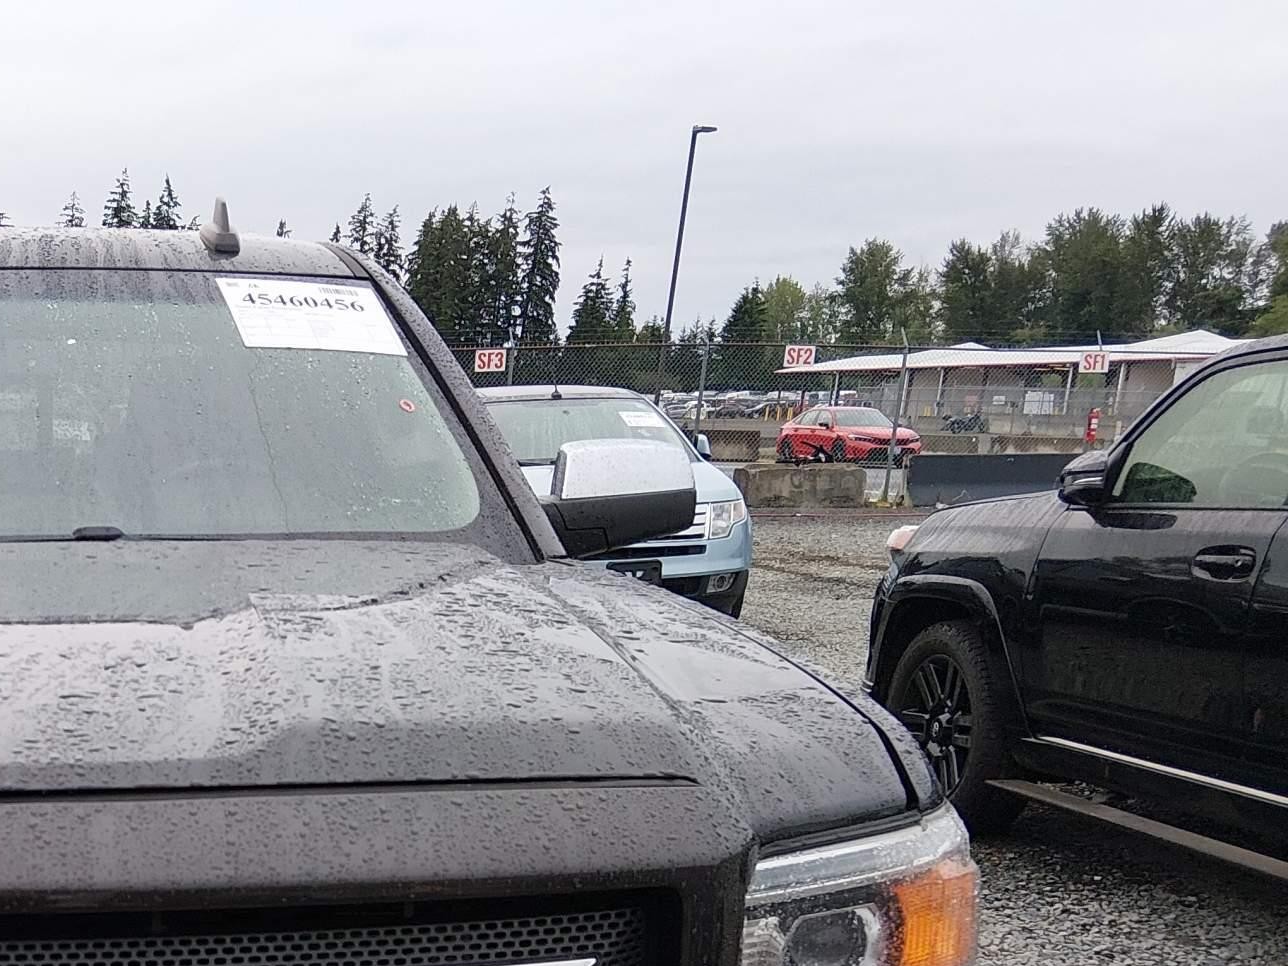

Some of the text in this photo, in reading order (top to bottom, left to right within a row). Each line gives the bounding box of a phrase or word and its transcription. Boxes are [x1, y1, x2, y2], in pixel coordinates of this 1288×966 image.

[242, 292, 365, 312] 45460456
[477, 351, 504, 370] SF3
[787, 348, 813, 365] SF2
[1083, 354, 1106, 371] SF1
